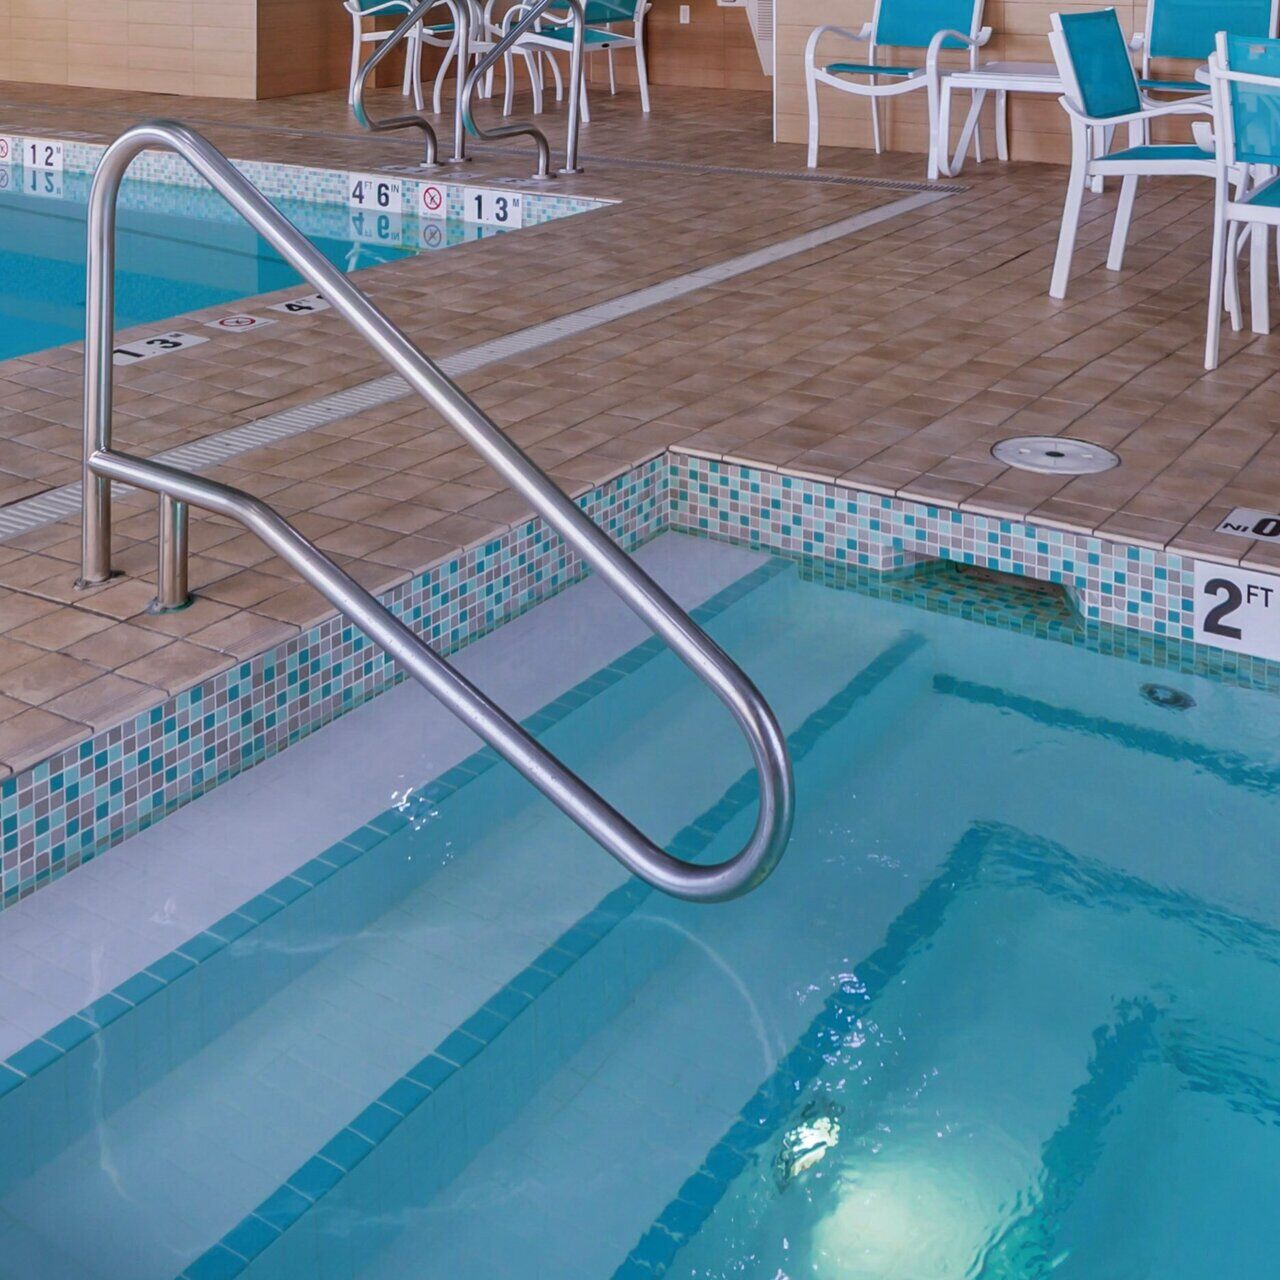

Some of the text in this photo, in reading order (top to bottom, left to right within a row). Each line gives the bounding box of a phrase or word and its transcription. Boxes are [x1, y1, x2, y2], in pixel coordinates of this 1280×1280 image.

[352, 181, 399, 207] 4 FT 6 IN
[512, 198, 520, 208] M
[1222, 522, 1251, 533] IN
[1203, 578, 1243, 640] 2
[1247, 584, 1274, 608] FT
